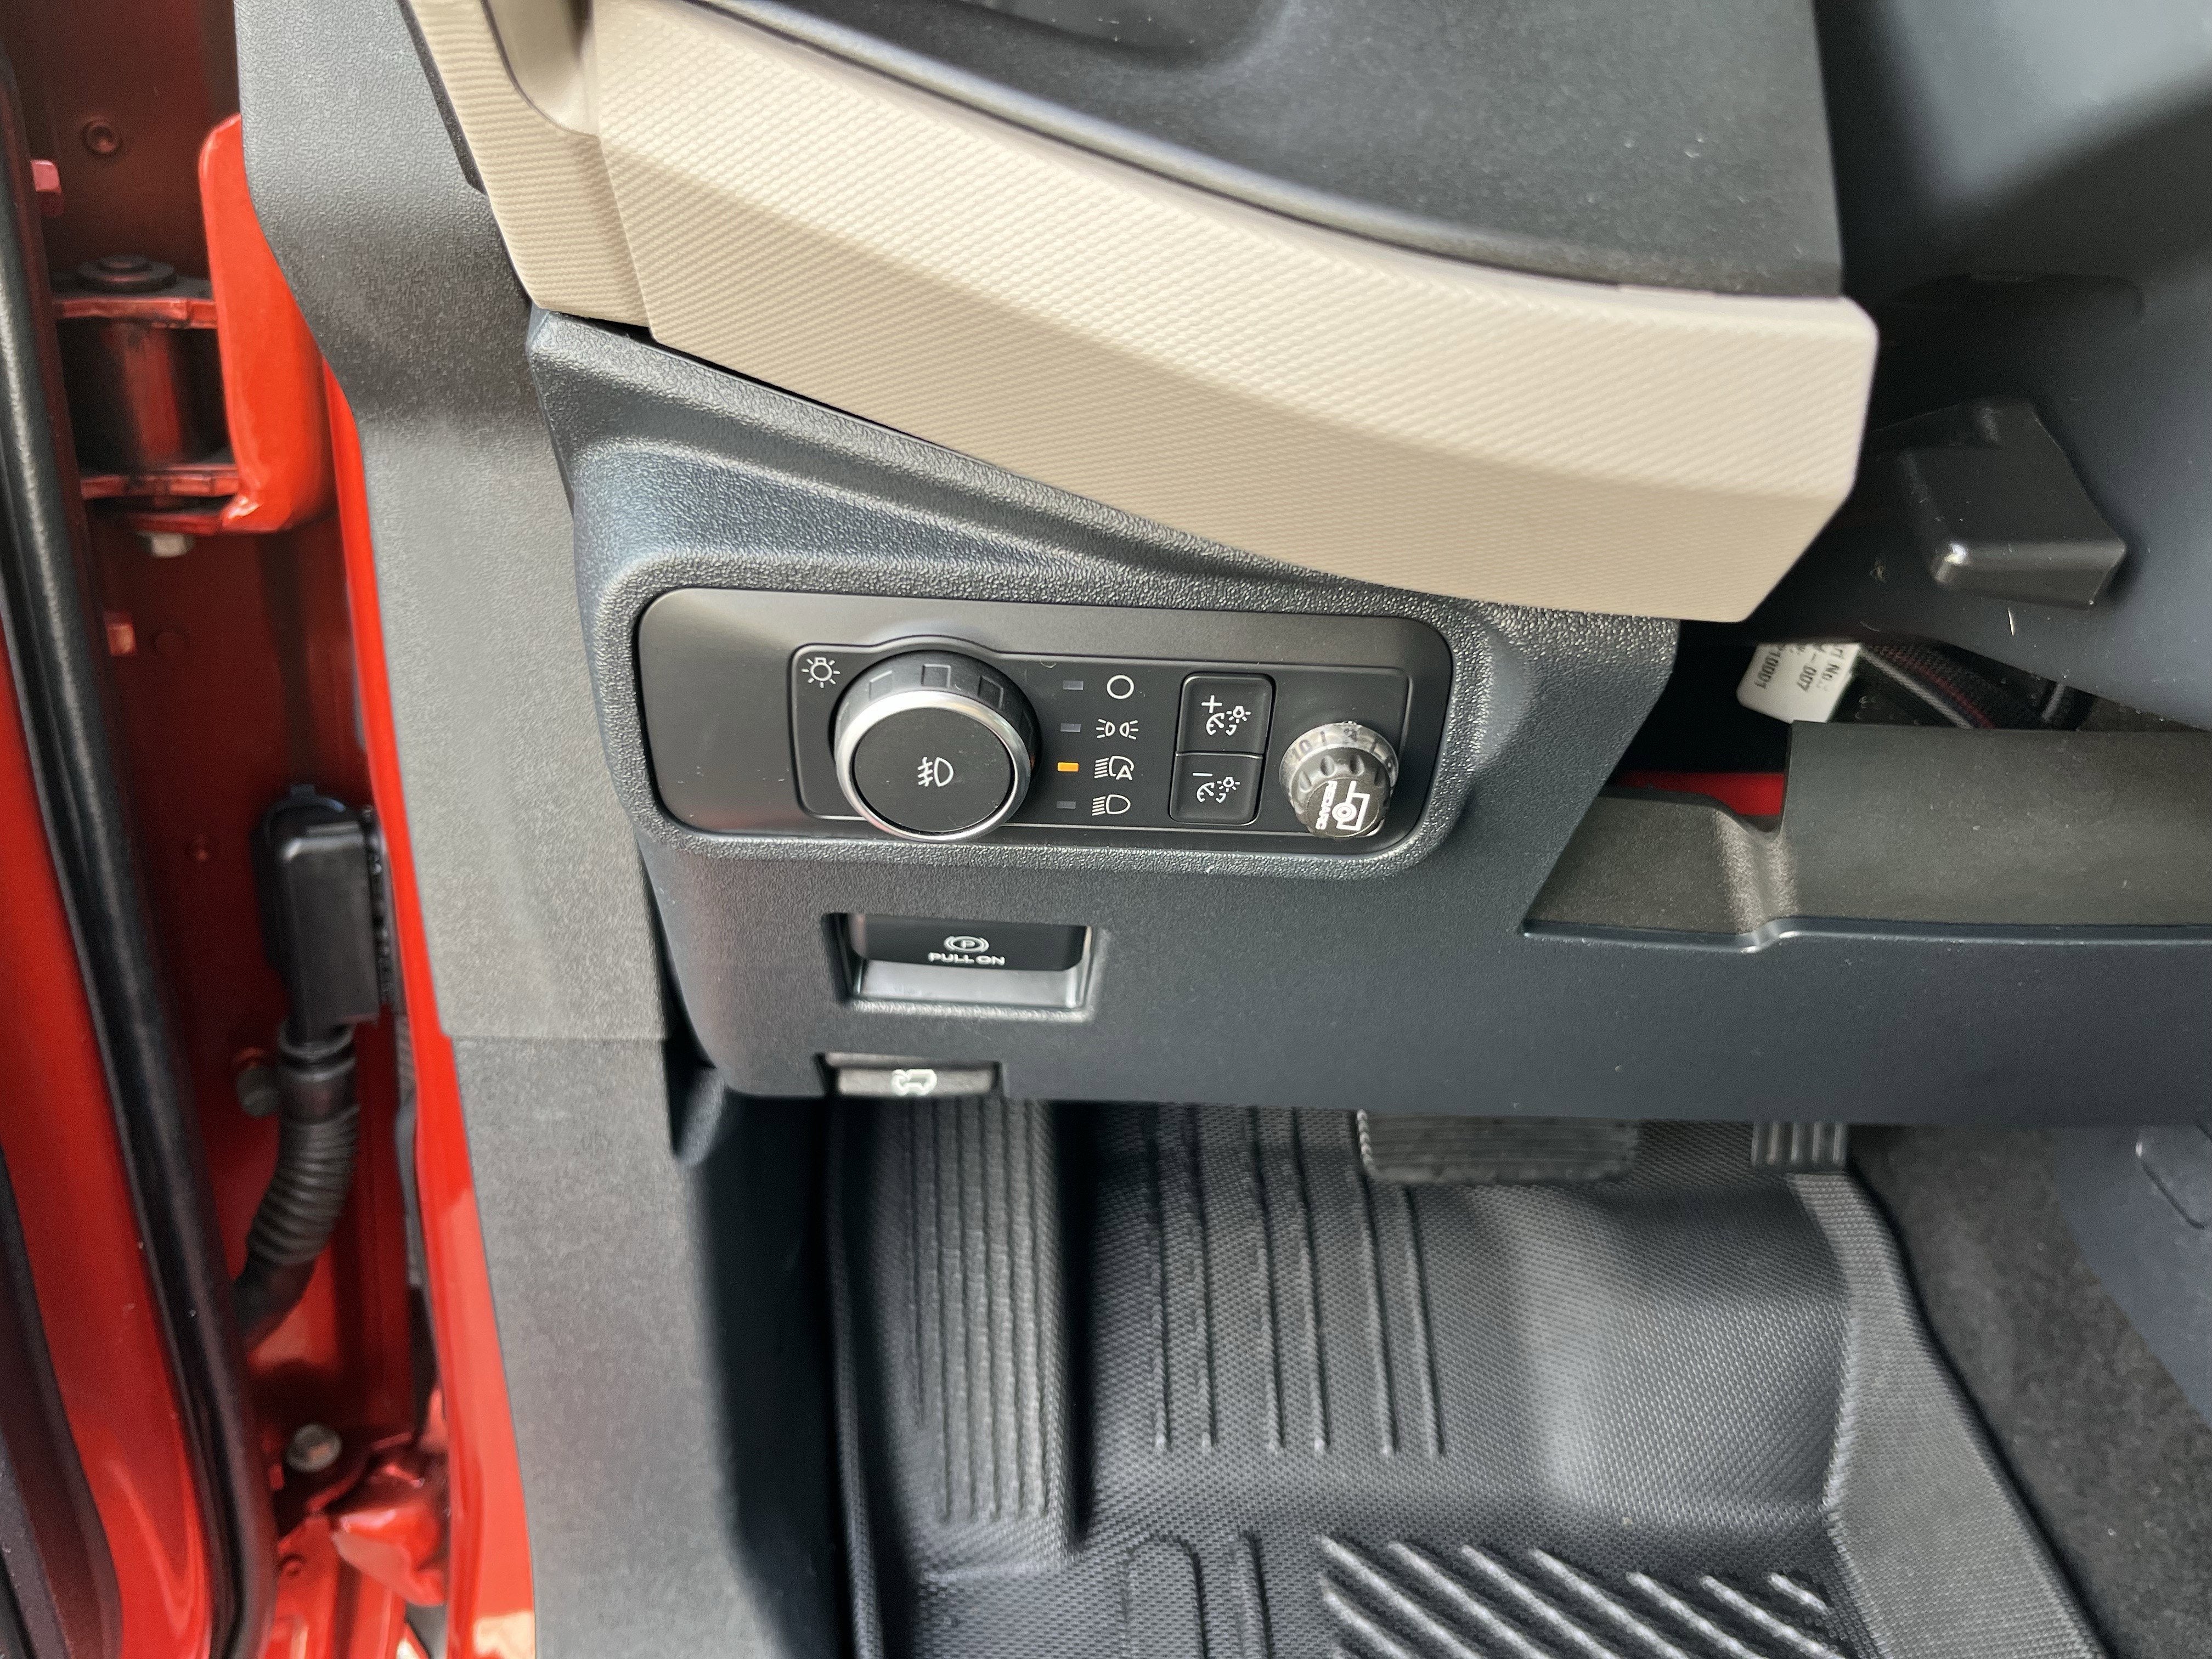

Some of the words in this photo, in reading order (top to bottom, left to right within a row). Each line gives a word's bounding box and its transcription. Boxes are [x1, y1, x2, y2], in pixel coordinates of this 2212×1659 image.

[1315, 780, 1338, 830] REDARC
[928, 952, 975, 964] PULL
[975, 955, 1006, 966] ON
